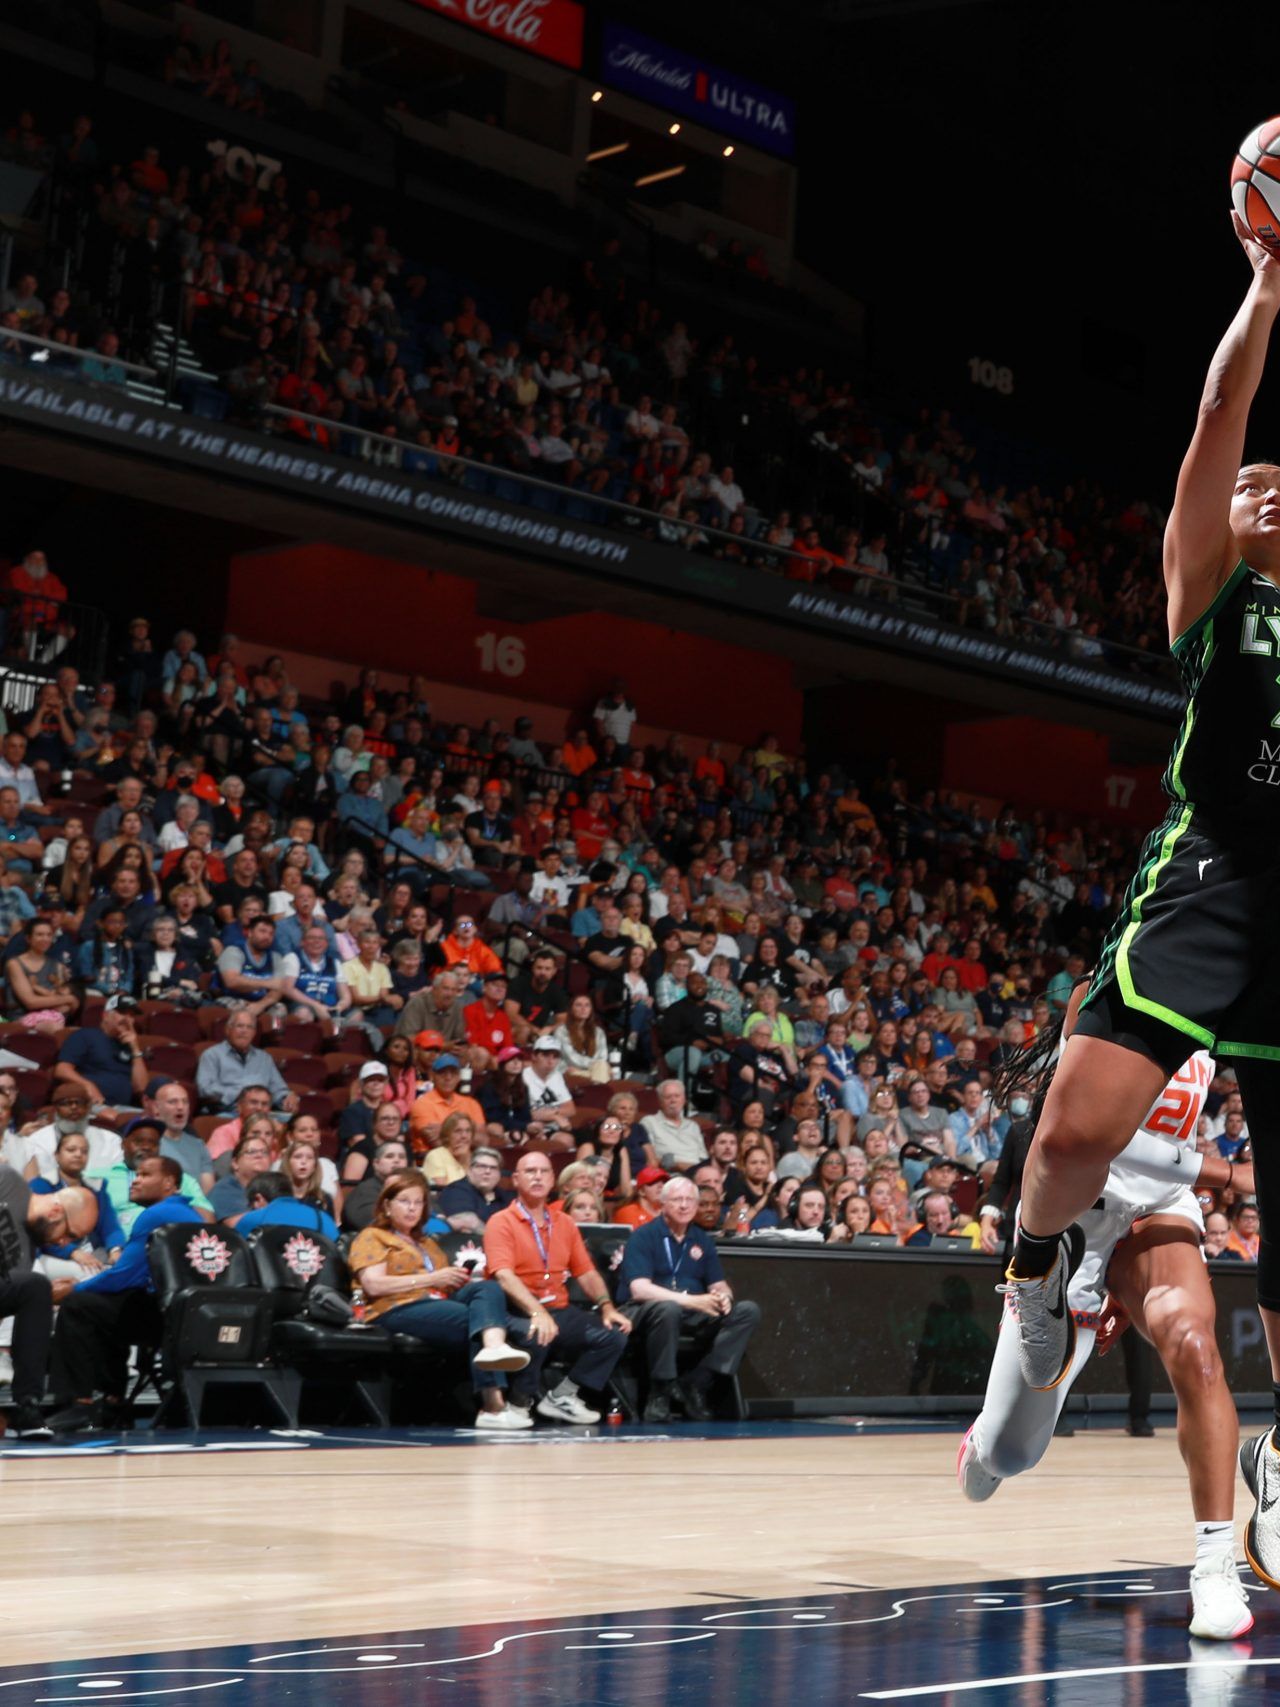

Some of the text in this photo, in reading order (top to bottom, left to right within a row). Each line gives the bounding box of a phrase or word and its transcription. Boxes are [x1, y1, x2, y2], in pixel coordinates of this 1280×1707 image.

[710, 82, 790, 136] ULTRA
[968, 355, 1015, 395] 108
[0, 379, 629, 563] VAILABLE AT THE NEAREST ARENA CONCESSIONS BOOTH
[474, 631, 527, 677] 16
[787, 592, 883, 632] AVAILABLE
[880, 617, 907, 637] AT
[906, 622, 940, 646] THE
[936, 630, 1008, 662] NEAREST
[1006, 650, 1056, 676] ARENA
[1104, 774, 1136, 809] 17
[1173, 1057, 1212, 1088] UN
[1145, 1088, 1200, 1141] 21
